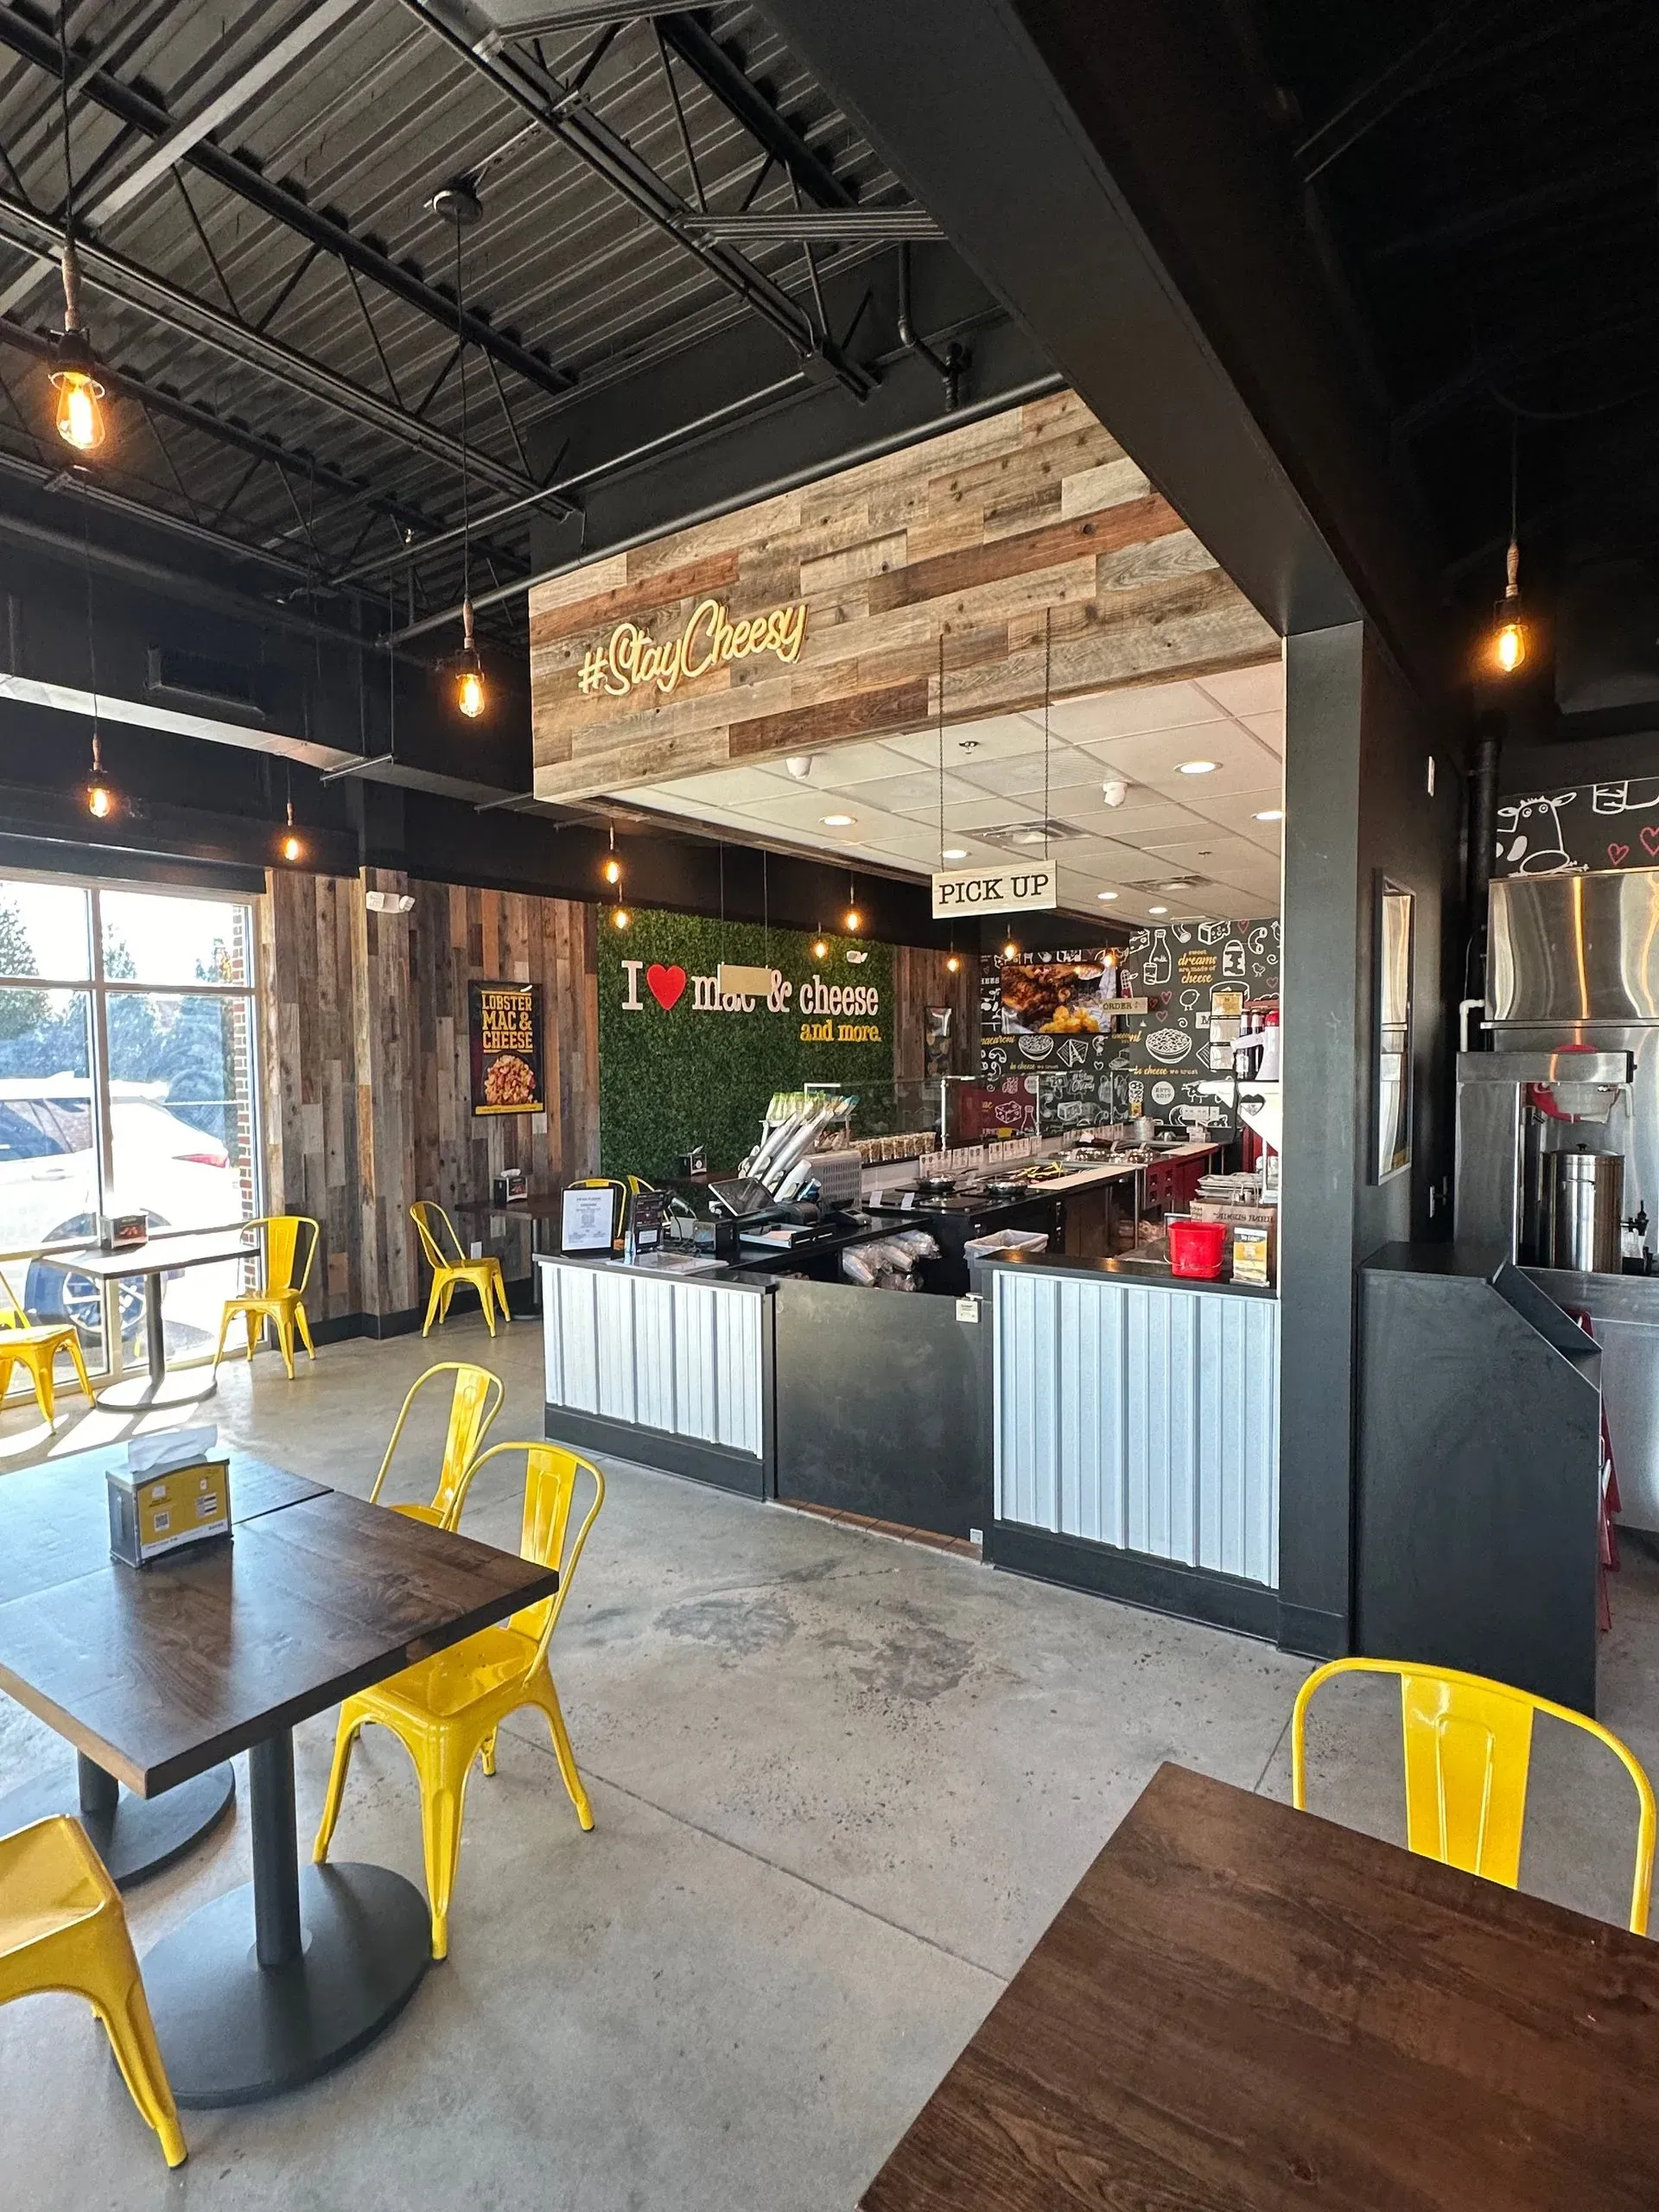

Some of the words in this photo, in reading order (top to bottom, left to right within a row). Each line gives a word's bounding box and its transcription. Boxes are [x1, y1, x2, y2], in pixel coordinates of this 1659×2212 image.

[577, 599, 810, 696] #StayCheesy
[938, 879, 1004, 905] PICK
[1010, 874, 1049, 898] UP
[1177, 952, 1217, 966] dreams
[1181, 970, 1213, 983] cheese
[620, 960, 644, 1011] I
[766, 969, 793, 1014] &
[799, 975, 880, 1016] cheese
[481, 995, 532, 1012] LOBSTER
[481, 1010, 517, 1031] MAC
[518, 1011, 532, 1032] &
[800, 1020, 832, 1042] and
[482, 1031, 533, 1050] CHEESE
[1144, 1064, 1168, 1075] cheese
